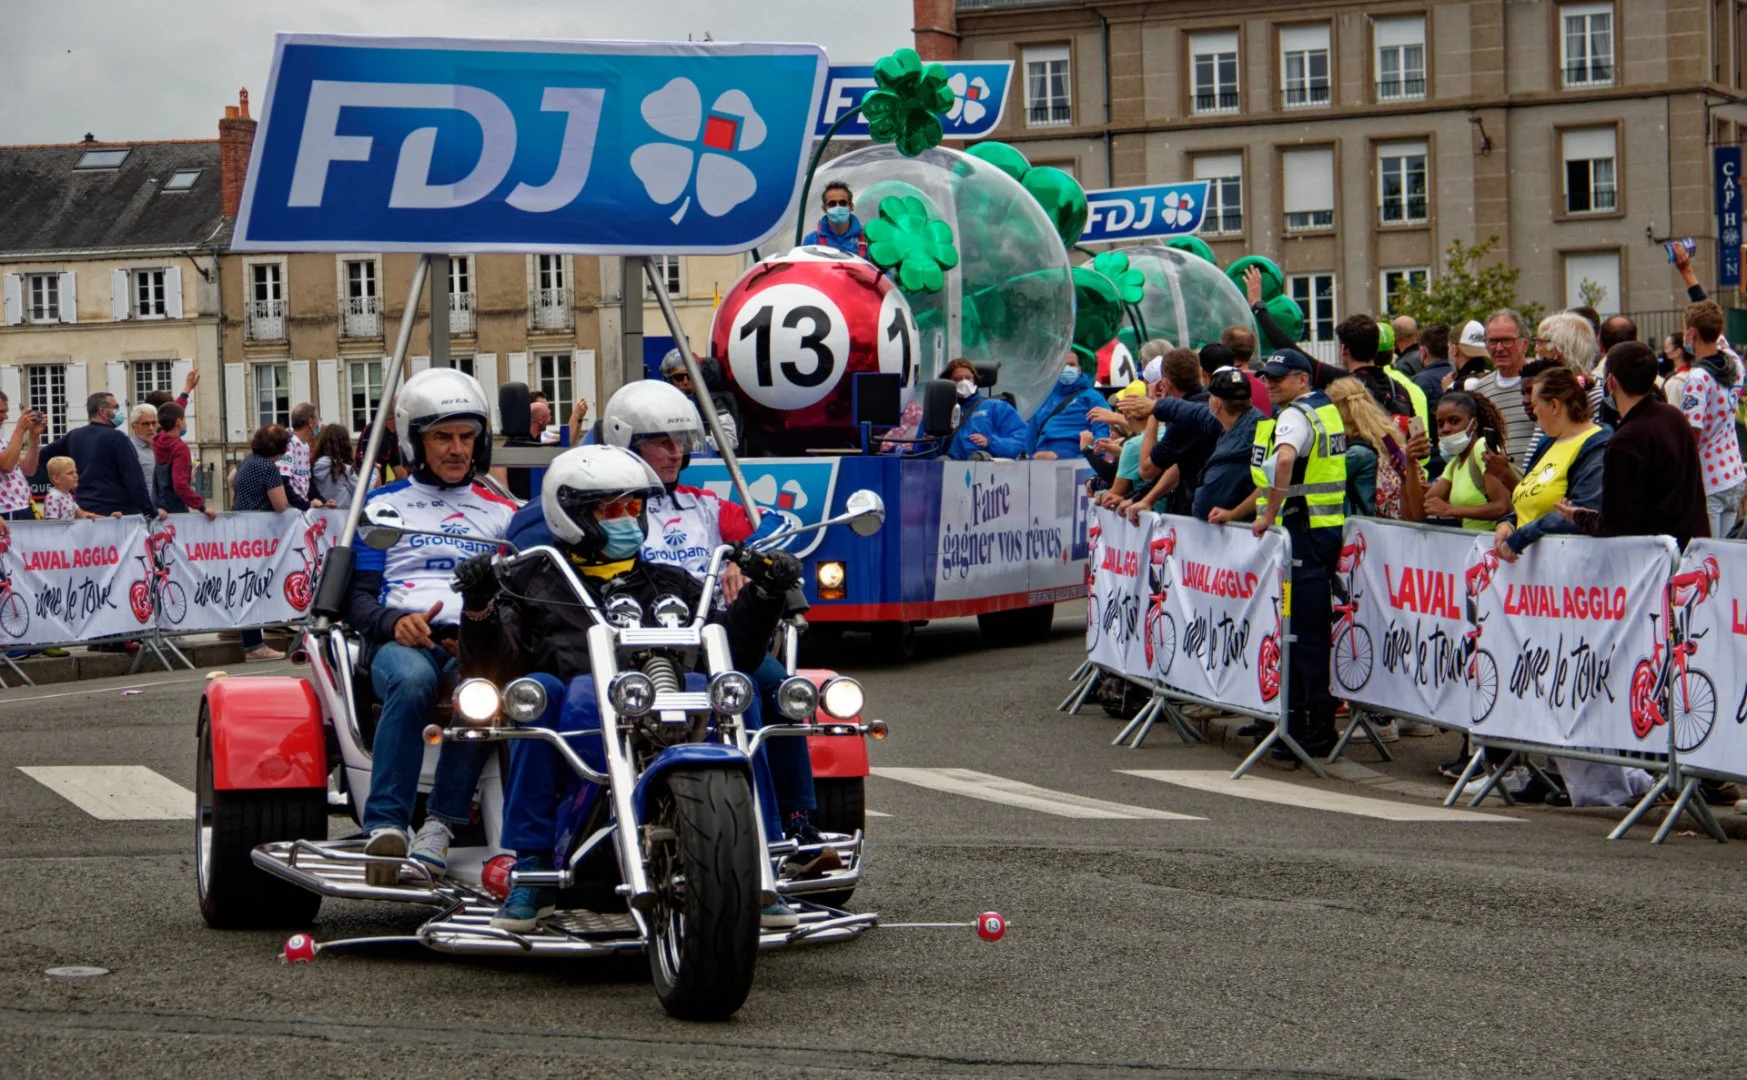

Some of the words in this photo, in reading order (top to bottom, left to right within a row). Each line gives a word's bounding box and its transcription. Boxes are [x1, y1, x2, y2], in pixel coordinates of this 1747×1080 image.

[287, 80, 606, 213] FDJ
[1083, 196, 1156, 234] FDJ
[740, 305, 834, 387] 13
[972, 473, 1010, 526] Faire
[22, 550, 71, 571] LAVAL
[72, 545, 119, 569] AGGLO
[185, 542, 228, 561] LAVAL
[229, 538, 279, 559] AGGLO
[942, 524, 994, 581] gagner
[998, 529, 1022, 562] vos
[1026, 516, 1062, 560] rêves
[1181, 559, 1210, 594] LAVAL
[1383, 563, 1461, 620] LAVAL
[1503, 583, 1561, 618] LAVAL
[1562, 585, 1627, 621] AGGLO
[987, 920, 999, 931] 13
